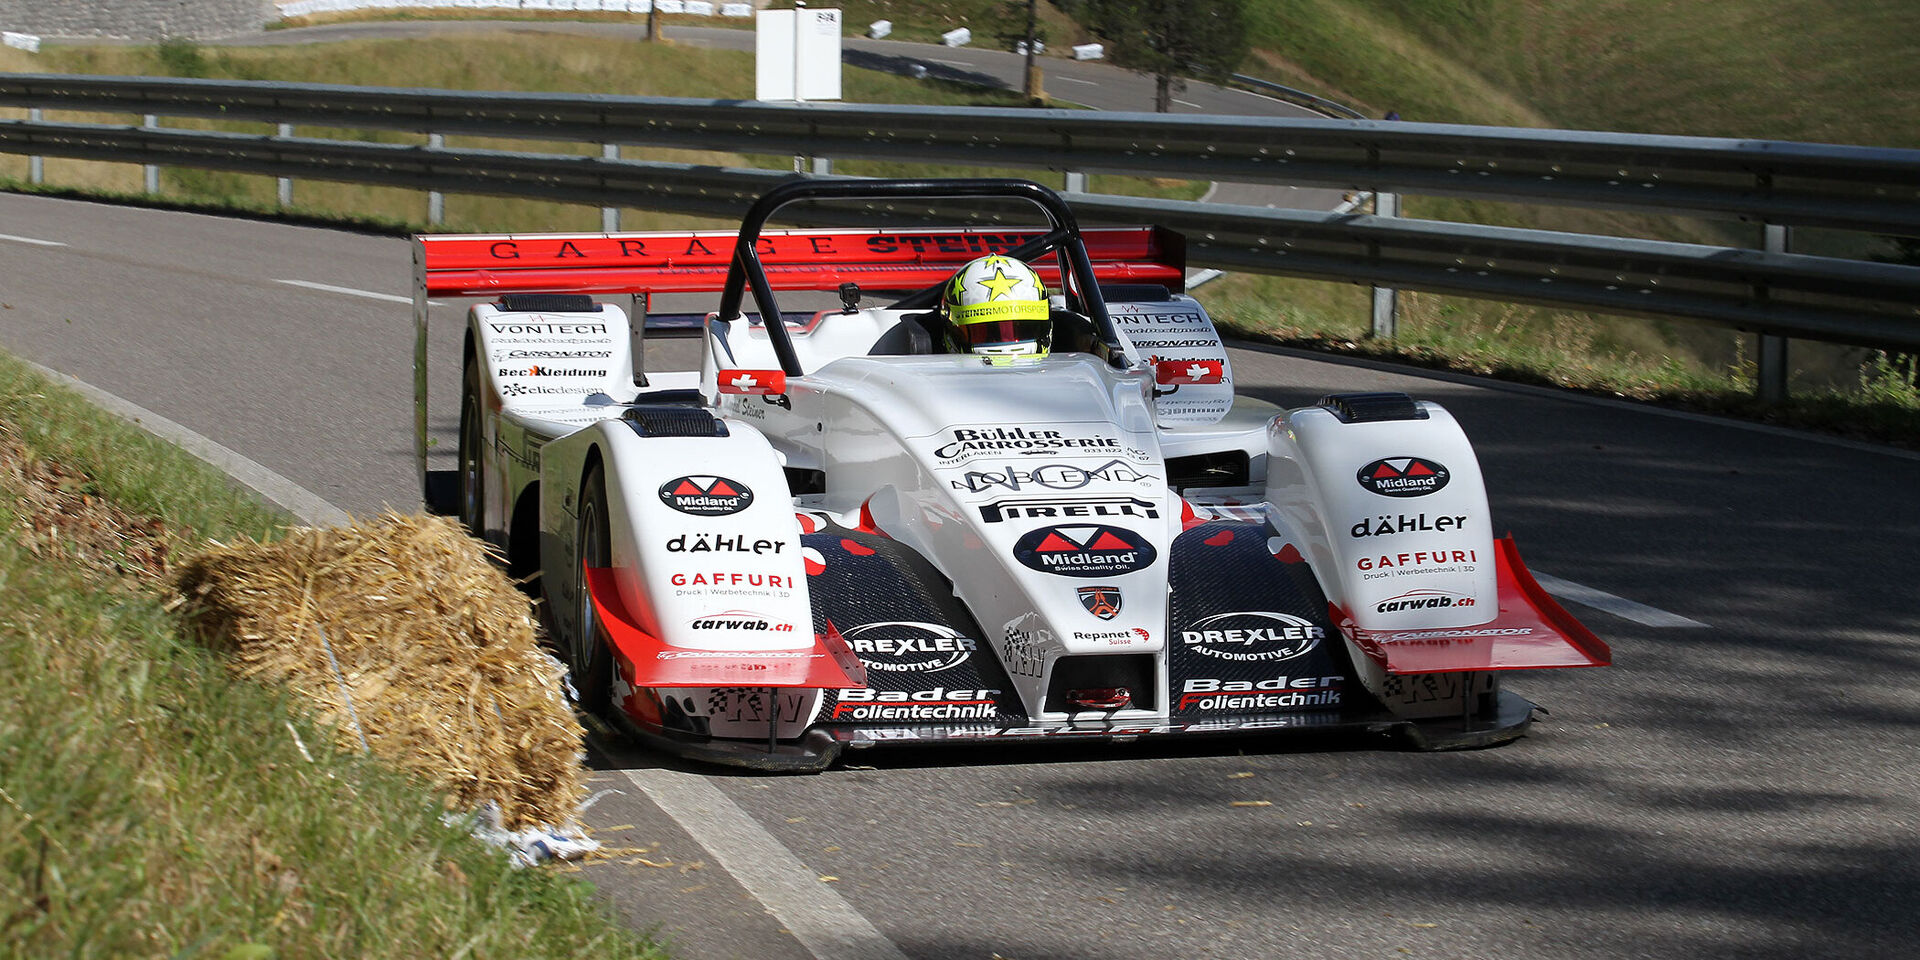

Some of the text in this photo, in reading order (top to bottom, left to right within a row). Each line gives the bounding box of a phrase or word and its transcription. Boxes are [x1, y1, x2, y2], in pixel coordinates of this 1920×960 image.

[490, 238, 838, 259] GARAGE
[490, 323, 608, 334] VONTECH
[1130, 338, 1219, 348] ARBONATOR
[508, 349, 613, 360] CARBONATOR
[528, 386, 605, 395] clicdesign
[938, 450, 1002, 465] INTERLAKEN
[1376, 477, 1437, 489] Midland
[676, 496, 738, 506] Midland
[978, 496, 1160, 523] PIRELLI
[1041, 552, 1136, 565] Midland
[1357, 550, 1477, 571] GAFFURI
[1363, 571, 1390, 580] Druck
[1396, 566, 1456, 576] Werbetechnik
[671, 573, 793, 588] GAFFURI
[676, 589, 702, 597] Druck
[710, 589, 771, 597] Werbetechnik
[1376, 596, 1475, 613] carwab.ch
[692, 619, 793, 632] carwab.ch
[1073, 631, 1131, 642] Repanet
[1181, 626, 1326, 646] DREXLER
[1395, 627, 1534, 641] CARBONATOR
[1190, 645, 1294, 661] AUTOMOTIVE
[1182, 675, 1345, 692] Bader
[837, 687, 1001, 701] Bader
[1178, 690, 1342, 711] Folientechnik
[832, 700, 998, 719] Folientechnik
